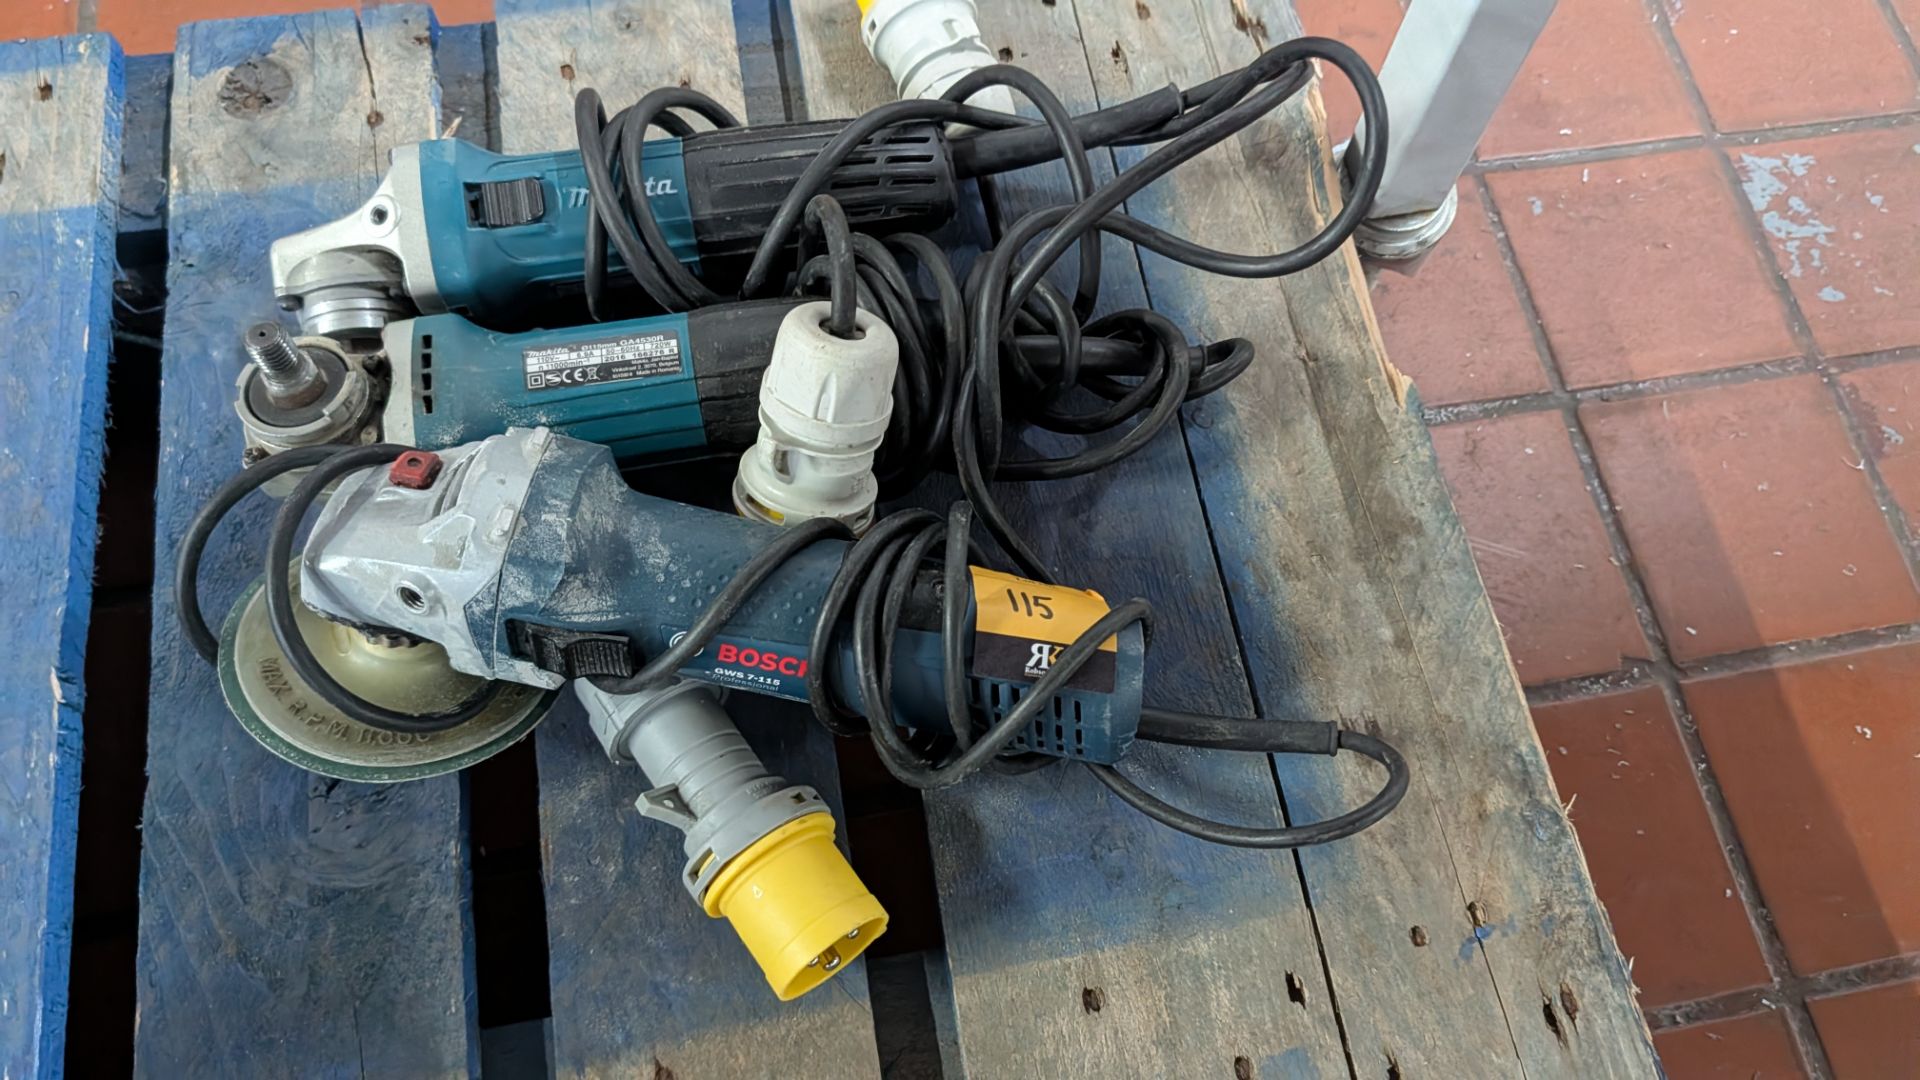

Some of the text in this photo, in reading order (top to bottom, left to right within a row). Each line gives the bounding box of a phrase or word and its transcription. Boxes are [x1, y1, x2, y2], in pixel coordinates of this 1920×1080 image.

[564, 177, 678, 208] mta
[527, 347, 569, 358] makita
[619, 335, 664, 346] GA4530R
[605, 354, 626, 362] 2016
[1006, 588, 1054, 620] 115
[711, 674, 780, 691] Professional
[714, 667, 781, 686] GWS 7-115
